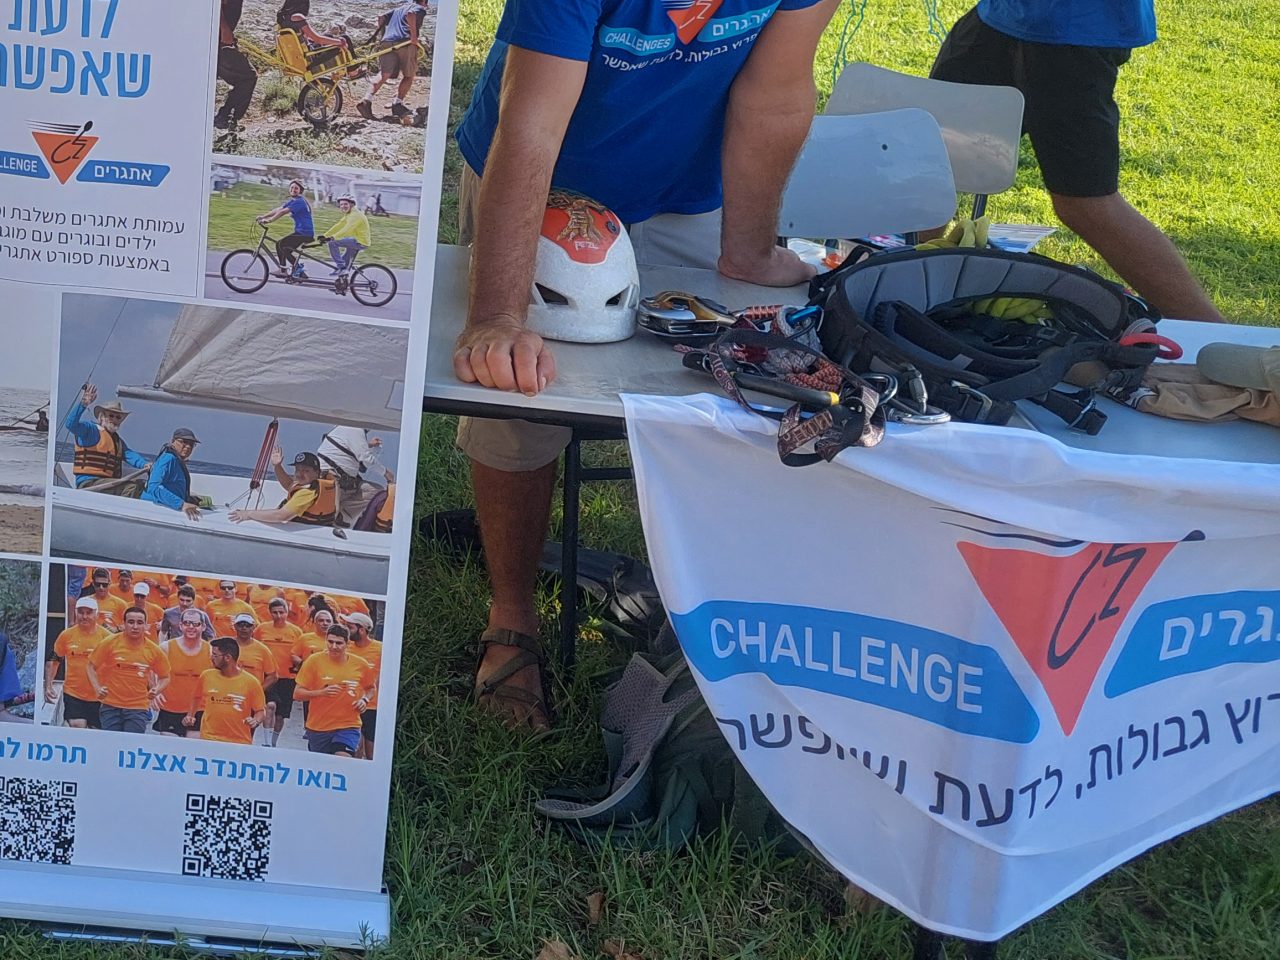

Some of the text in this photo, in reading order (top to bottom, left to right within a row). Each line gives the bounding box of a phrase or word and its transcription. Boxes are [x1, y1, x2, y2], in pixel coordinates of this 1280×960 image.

[604, 32, 672, 52] CHALLENGES
[601, 53, 649, 71] שאפשר
[684, 44, 728, 63] גבולות,
[94, 165, 153, 182] אתגרים
[10, 206, 66, 225] משלבת
[71, 212, 128, 229] אתגרים
[132, 216, 185, 235] עמותת
[31, 229, 53, 243] עם
[57, 231, 111, 248] ובוגרים
[115, 234, 156, 251] ילדים
[0, 245, 42, 263] אתגרי
[46, 249, 94, 266] ספורט
[98, 252, 171, 273] באמצעות
[1158, 605, 1280, 662] גרים
[709, 616, 984, 714] CHALLENGE
[27, 743, 88, 765] תרמו
[1075, 709, 1211, 800] גבולות,
[118, 747, 349, 792] בואו להתנדב אצלנו
[928, 764, 1063, 828] לדעת
